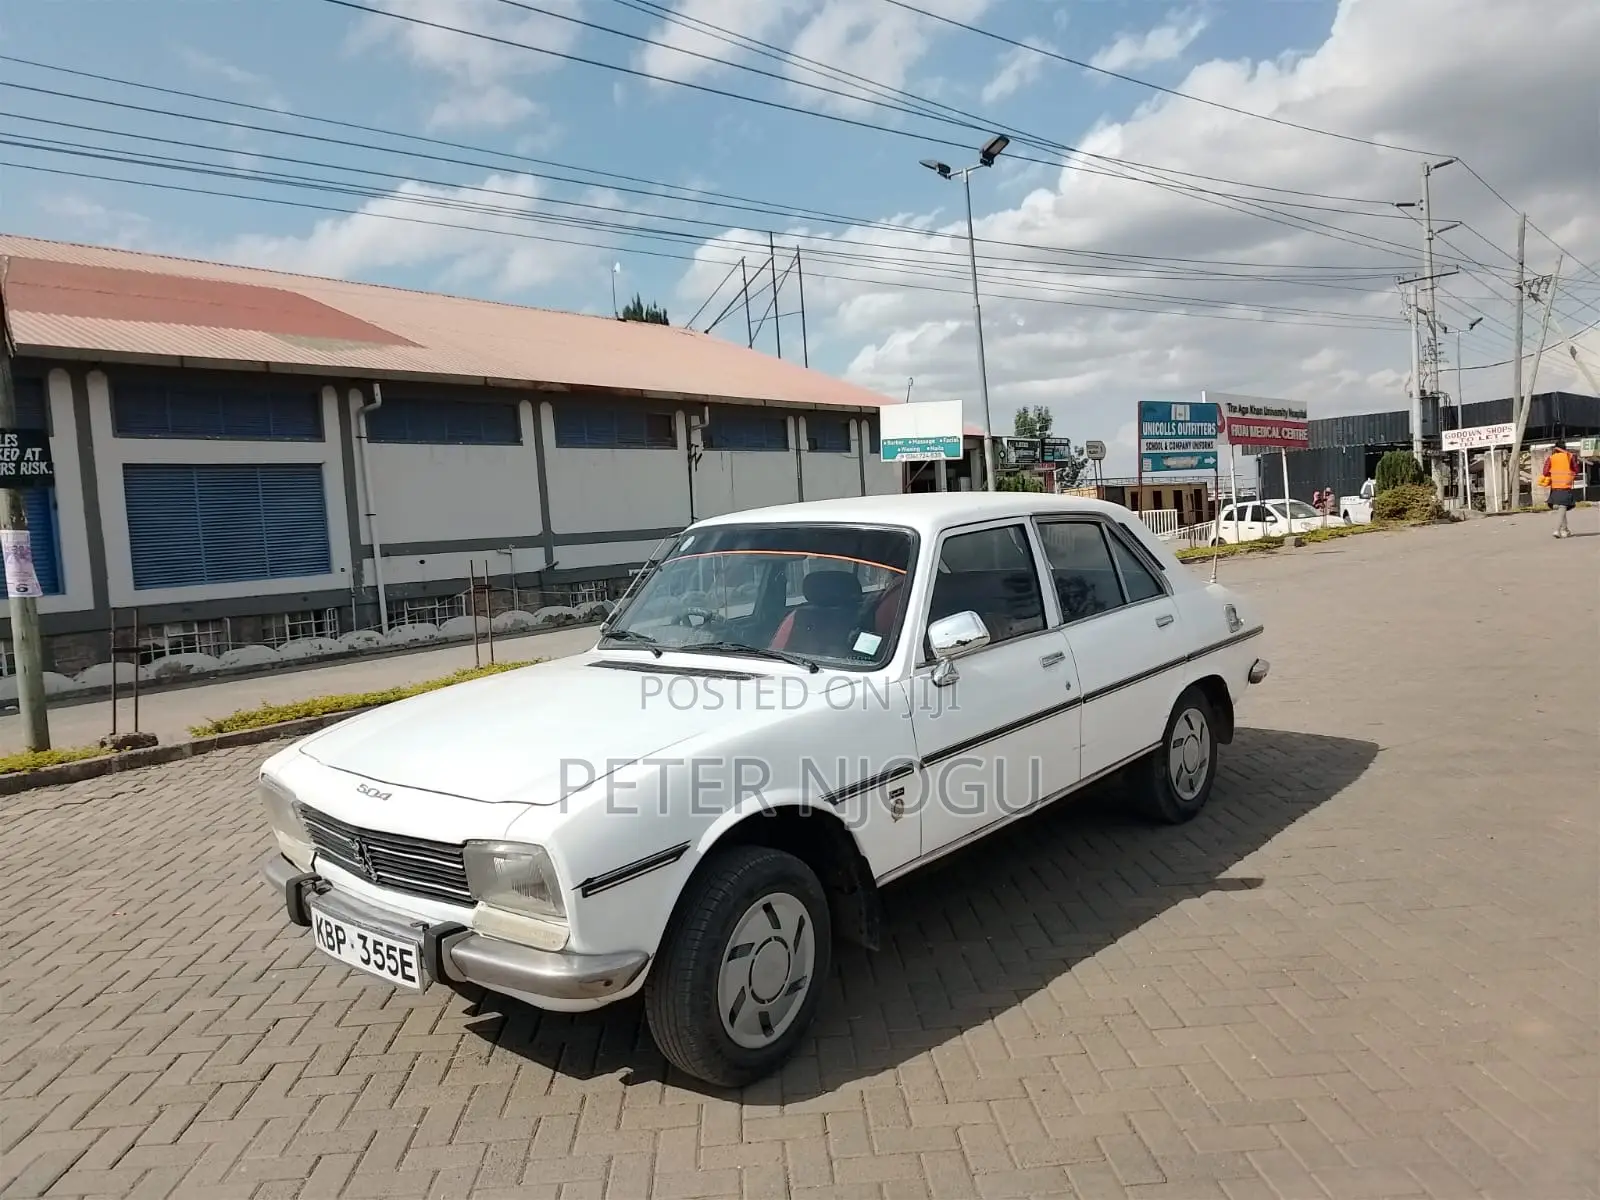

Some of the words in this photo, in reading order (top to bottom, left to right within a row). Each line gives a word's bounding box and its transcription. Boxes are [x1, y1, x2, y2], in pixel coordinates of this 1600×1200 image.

[1142, 422, 1176, 436] UNICOLLS
[1177, 422, 1216, 436] OUTFITTERS
[1250, 425, 1281, 439] MEDICAL
[1281, 427, 1309, 441] CENTRE
[1444, 430, 1482, 440] GODOWN
[1486, 425, 1513, 434] SHOPS
[1145, 441, 1164, 451] SCHOOL
[1168, 441, 1191, 450] COMPANY
[24, 447, 43, 461] AT
[0, 461, 16, 475] RS
[20, 461, 53, 475] RISK.
[356, 783, 392, 801] 504
[316, 914, 347, 955] KBP
[357, 933, 416, 983] 355E
